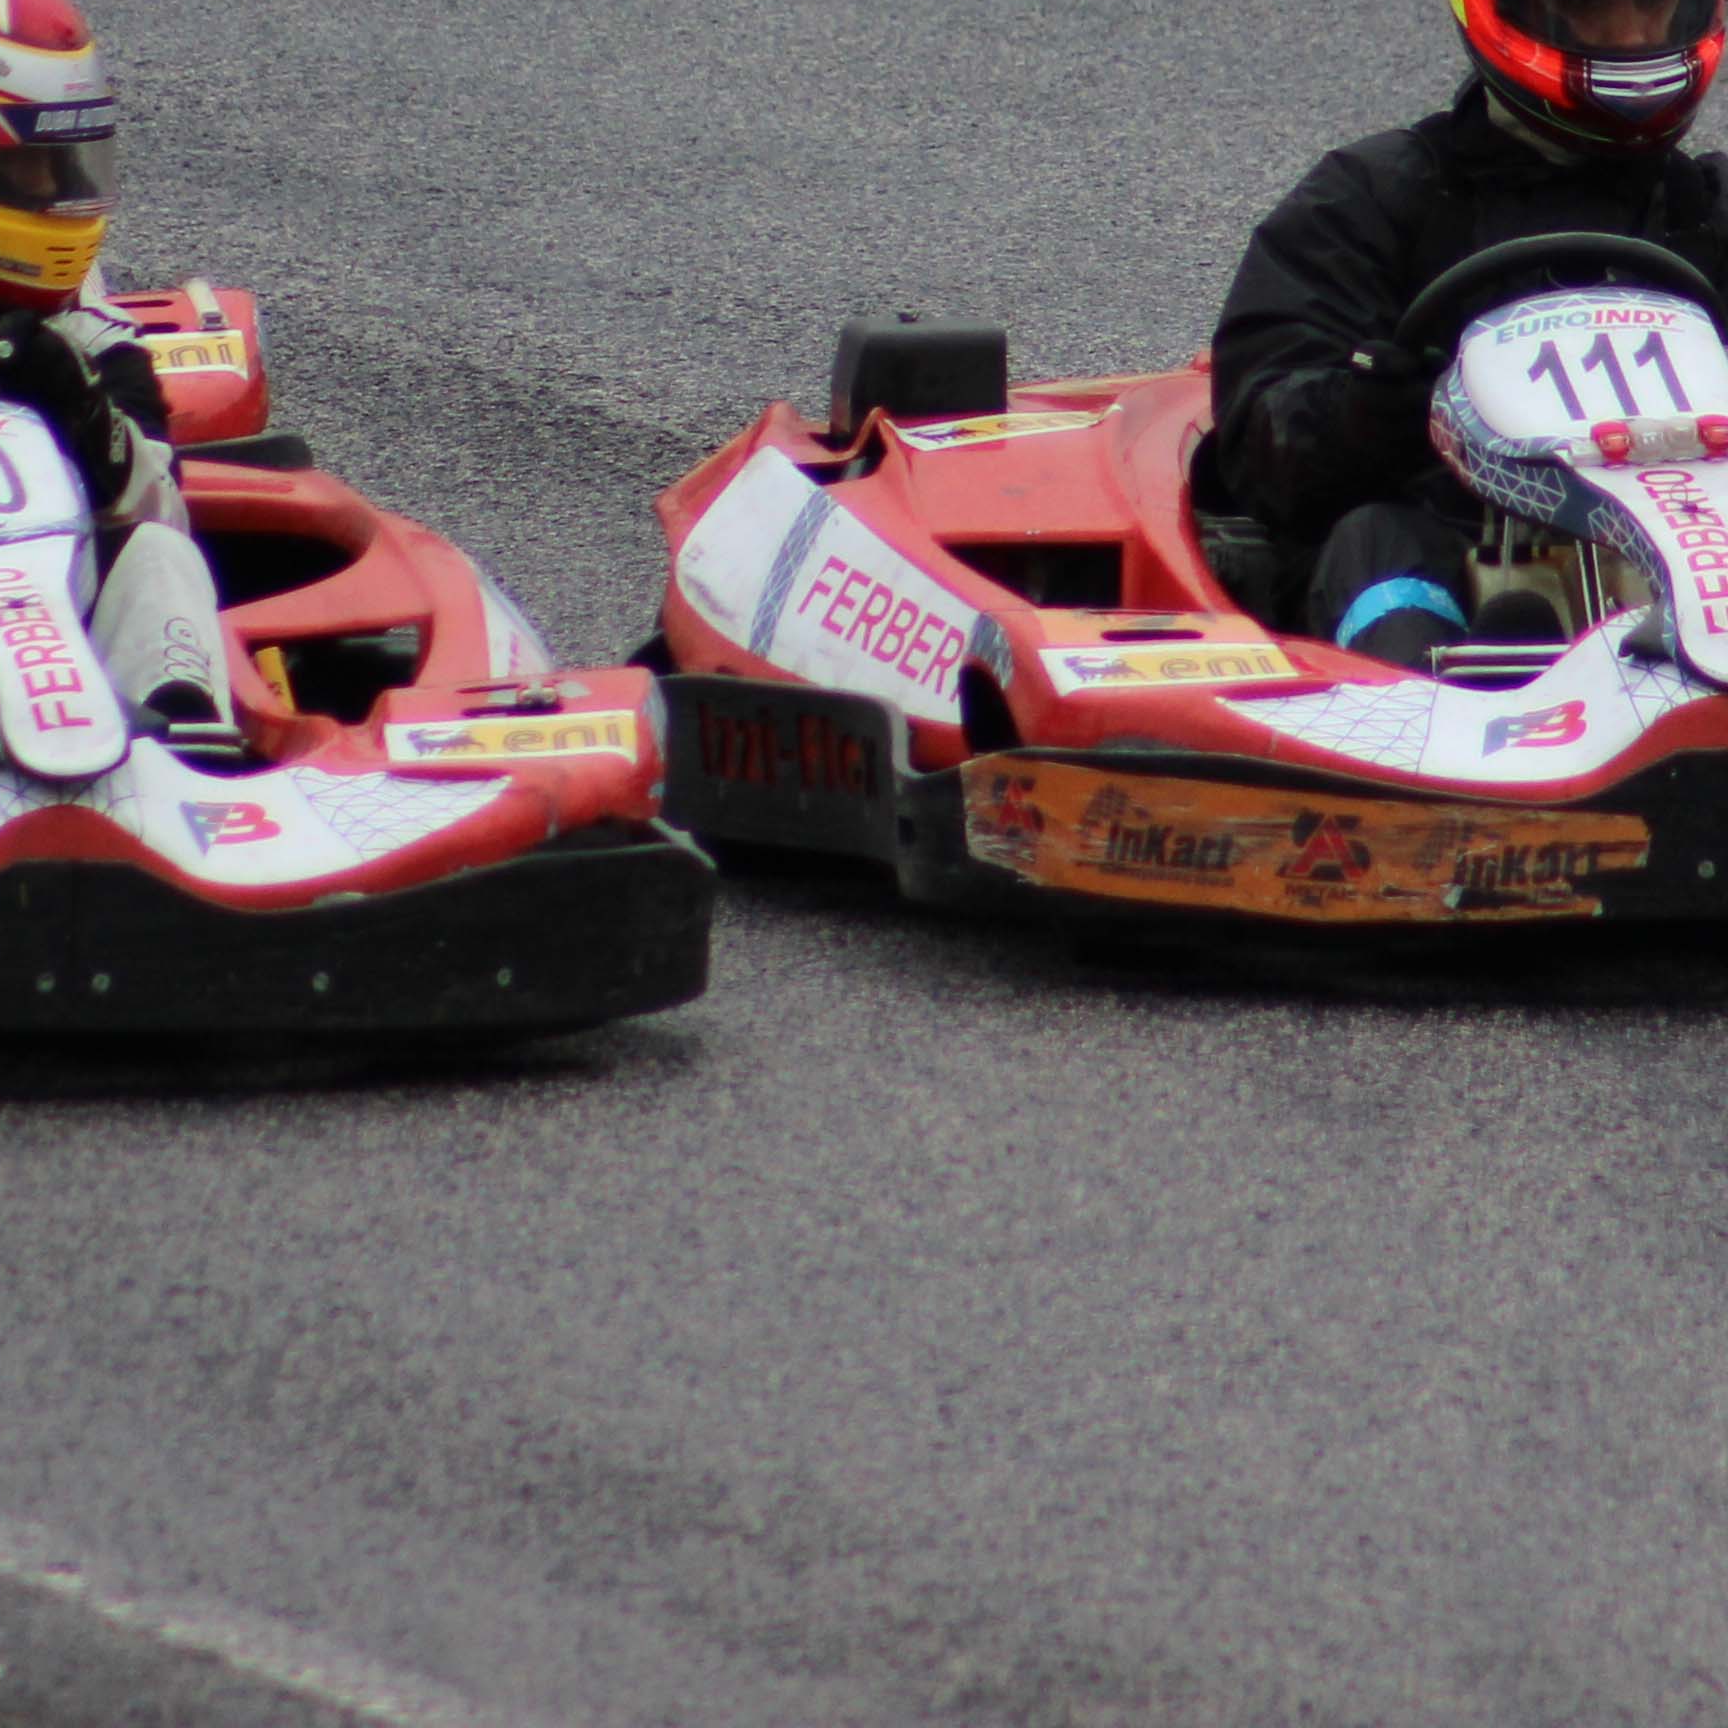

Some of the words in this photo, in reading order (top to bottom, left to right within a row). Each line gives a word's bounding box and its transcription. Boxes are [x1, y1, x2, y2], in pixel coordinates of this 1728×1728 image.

[1495, 309, 1679, 345] EUROINDY
[152, 335, 234, 368] ni
[1527, 330, 1693, 421] 111
[797, 554, 966, 703] FERBER
[1159, 646, 1273, 683] eni
[503, 715, 622, 753] eni
